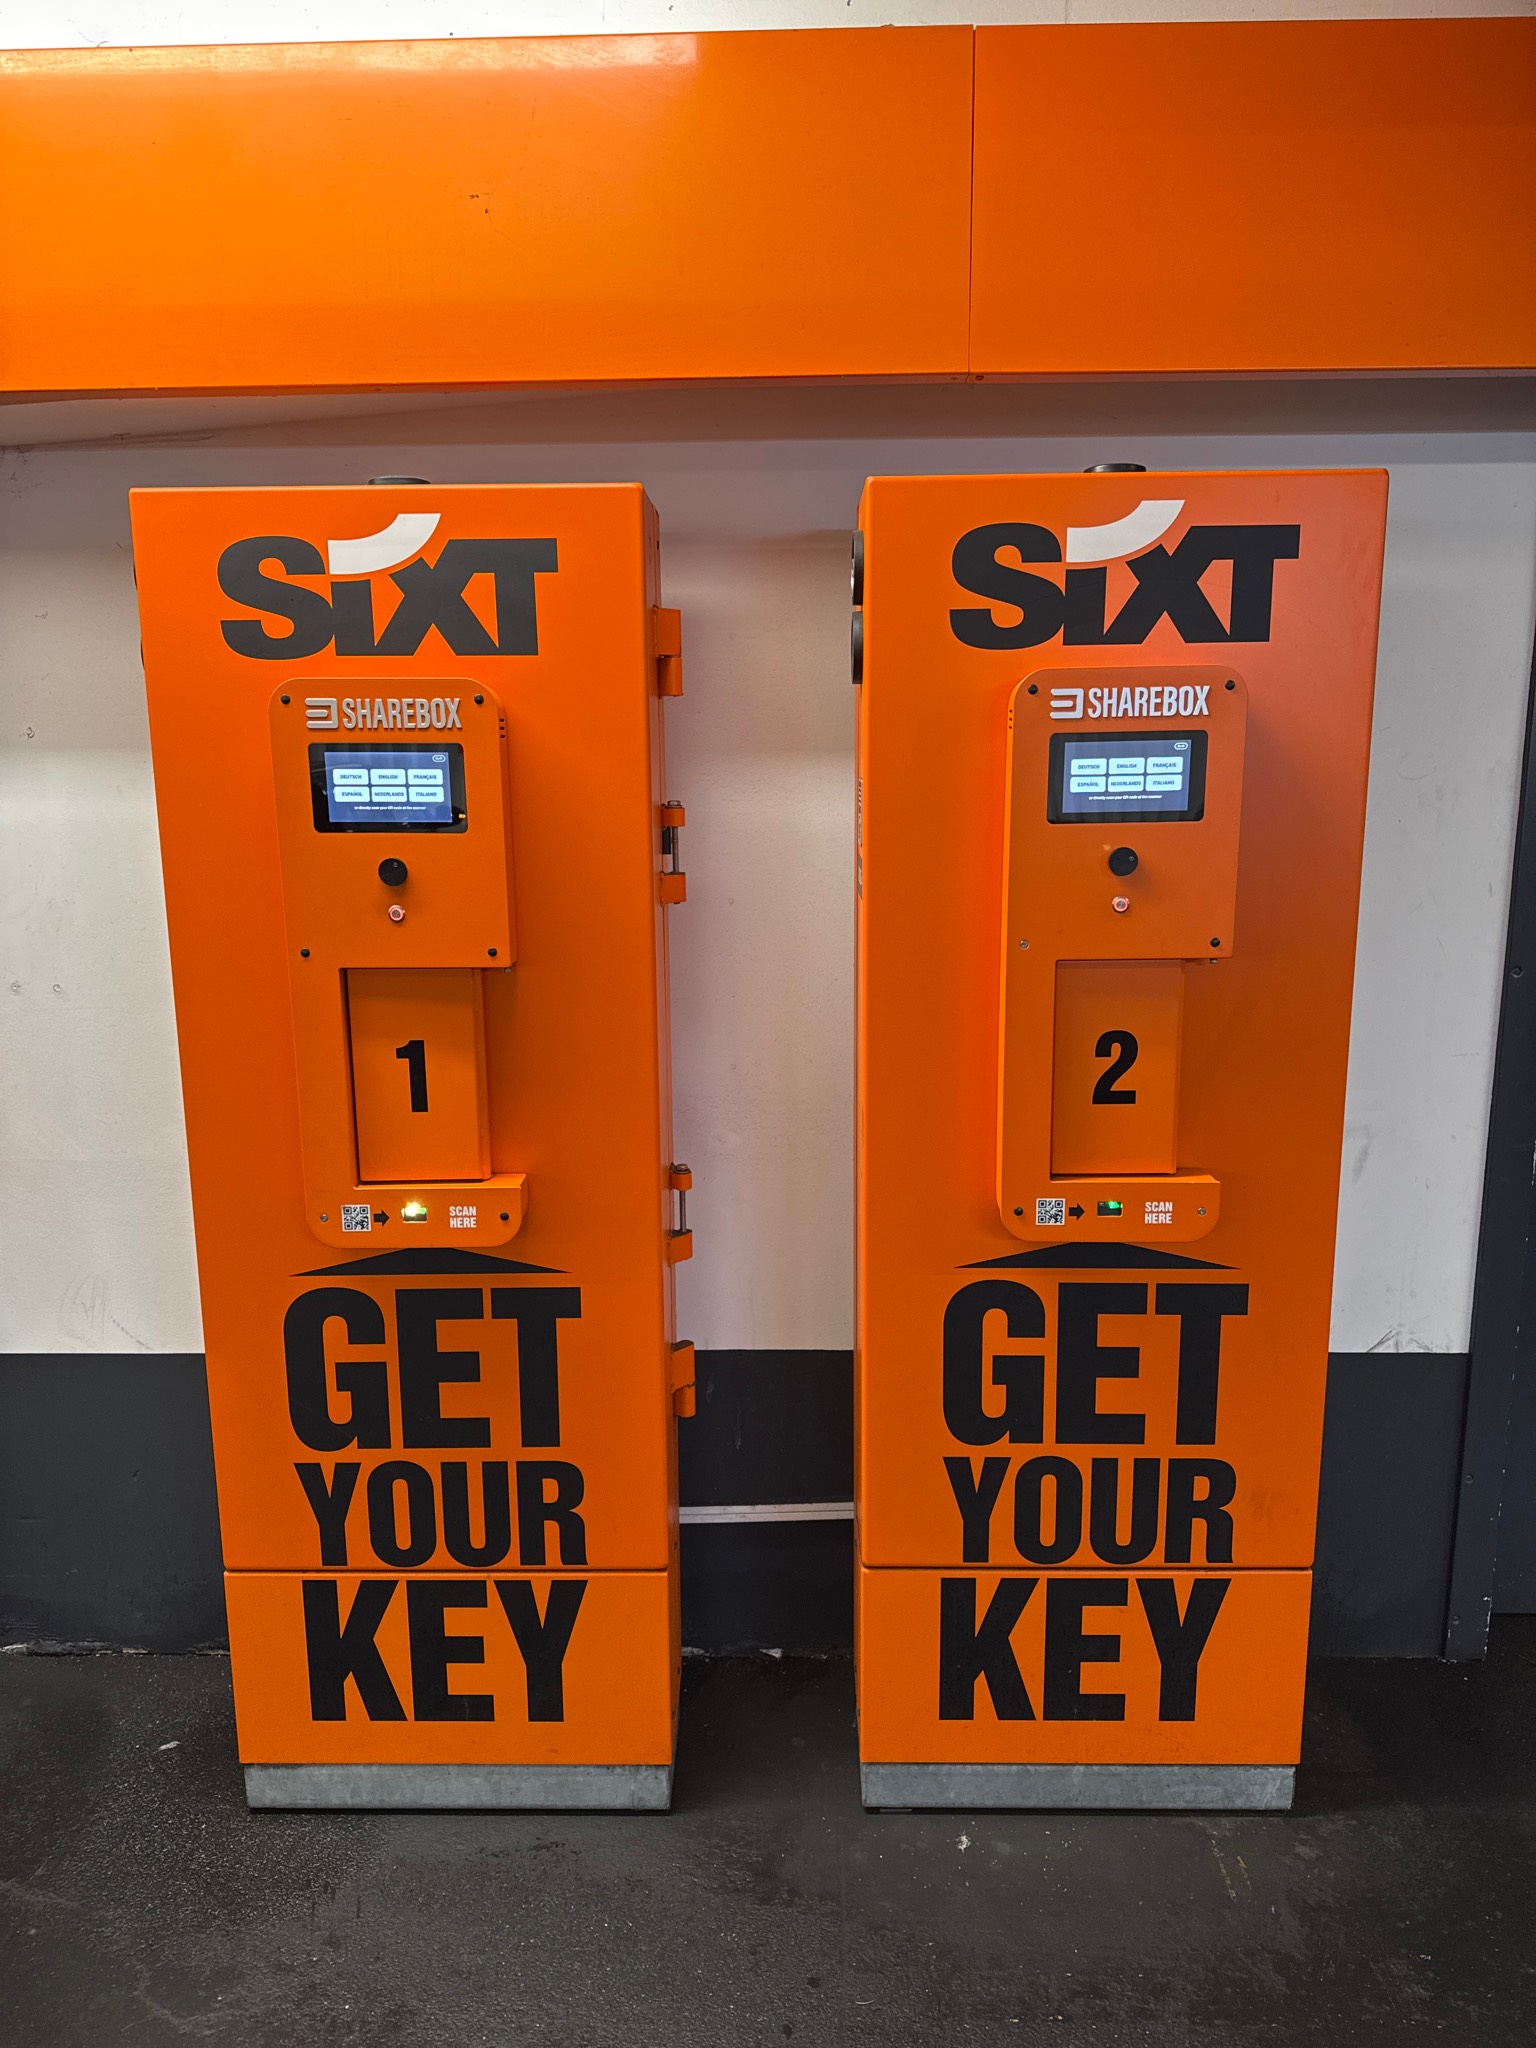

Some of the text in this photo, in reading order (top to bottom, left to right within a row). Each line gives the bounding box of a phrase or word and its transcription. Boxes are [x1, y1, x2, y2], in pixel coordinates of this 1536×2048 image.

[342, 697, 462, 730] SHAREBOX
[1087, 686, 1210, 718] SHAREBOX
[395, 1039, 430, 1113] 1
[1091, 1030, 1140, 1105] 2
[449, 1205, 477, 1217] SCAN
[449, 1217, 477, 1228] HERE
[1144, 1201, 1173, 1212] SCAN
[1144, 1213, 1172, 1224] HERE
[283, 1287, 582, 1451] GET
[942, 1279, 1250, 1446] GET
[293, 1460, 588, 1567] YOUR
[943, 1456, 1236, 1565] YOUR
[302, 1579, 588, 1722] KEY
[938, 1578, 1232, 1721] KEY
